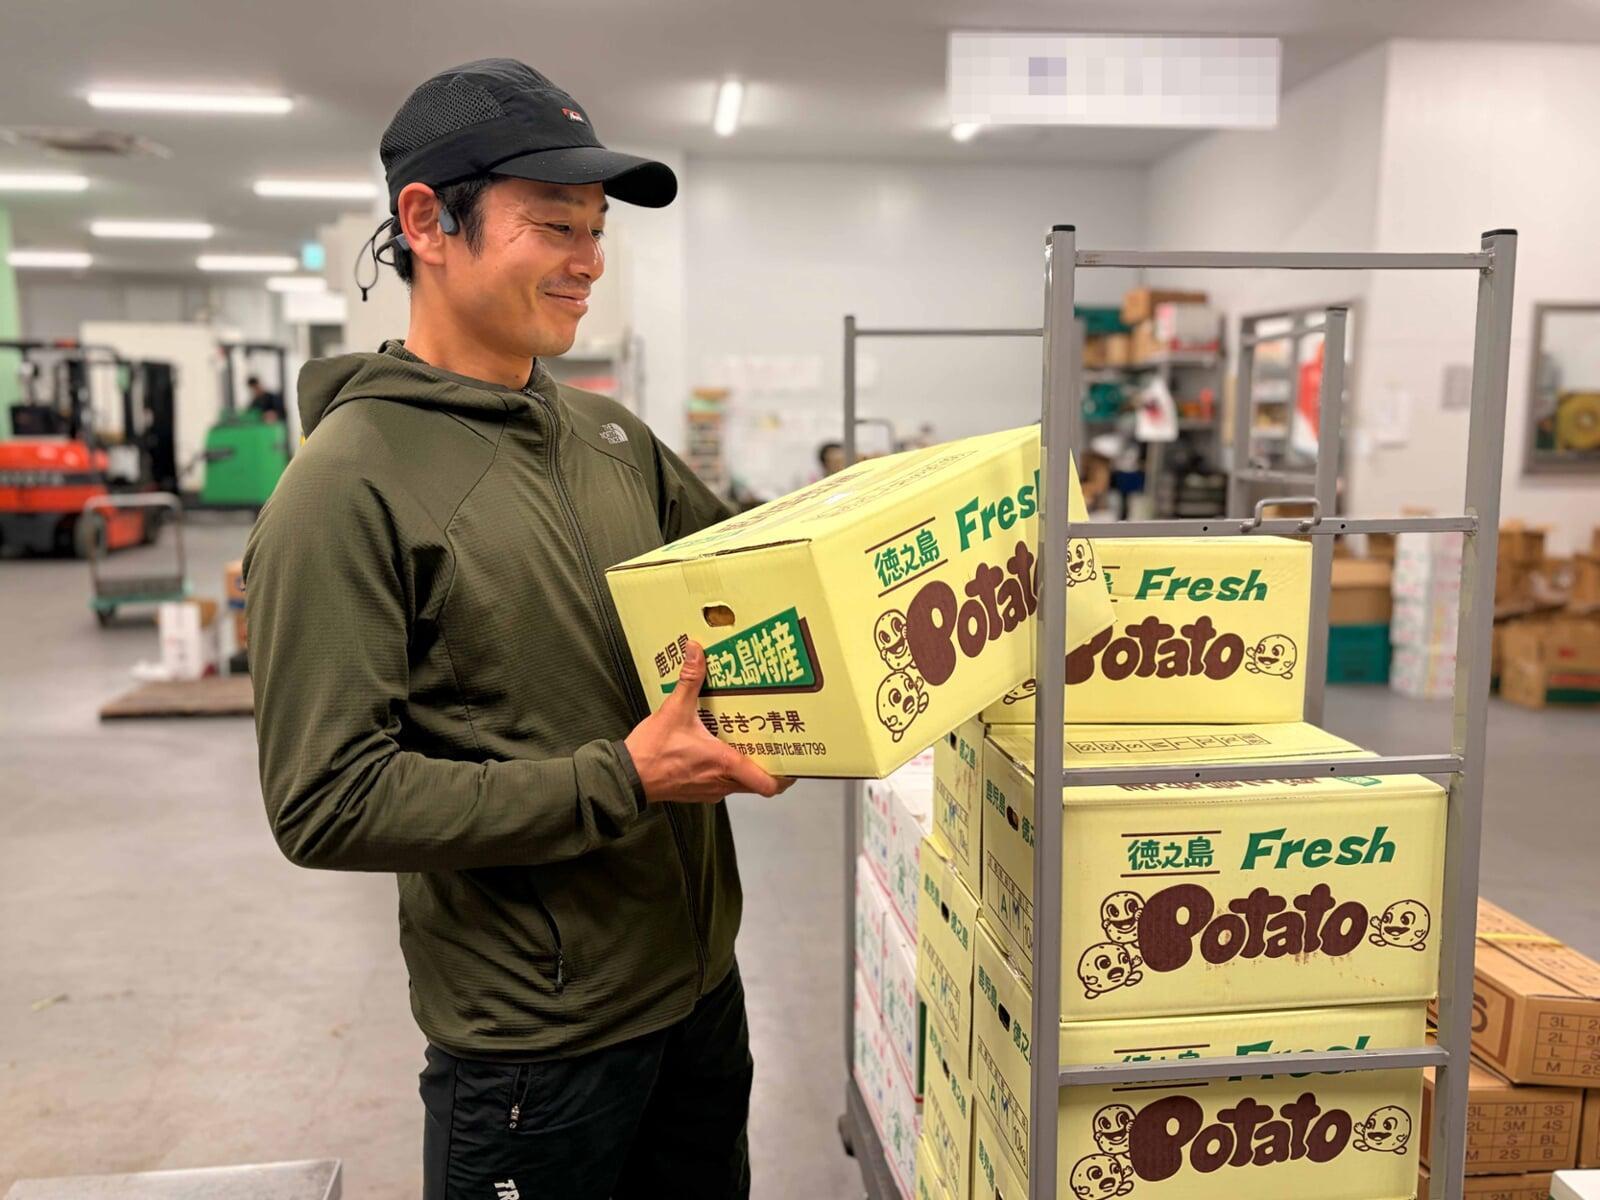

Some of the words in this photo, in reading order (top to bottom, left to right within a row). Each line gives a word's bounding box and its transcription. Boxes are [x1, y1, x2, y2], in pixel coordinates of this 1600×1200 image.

[873, 530, 939, 588] 徳之島
[1135, 566, 1268, 601] Fresh
[906, 541, 1039, 686] Potat
[1126, 835, 1216, 871] 徳之島
[1240, 826, 1396, 871] Fresh
[1138, 883, 1369, 973] Potato
[1551, 1016, 1570, 1028] 3L
[1588, 1020, 1600, 1031] 2
[1548, 1032, 1568, 1044] 2L
[1551, 1047, 1561, 1058] L
[1546, 1062, 1561, 1073] M
[1504, 1106, 1528, 1117] 2M
[1503, 1121, 1526, 1132] 3M
[1129, 1092, 1352, 1182] Potato
[1506, 1134, 1518, 1146] S
[1499, 1149, 1521, 1160] 2S
